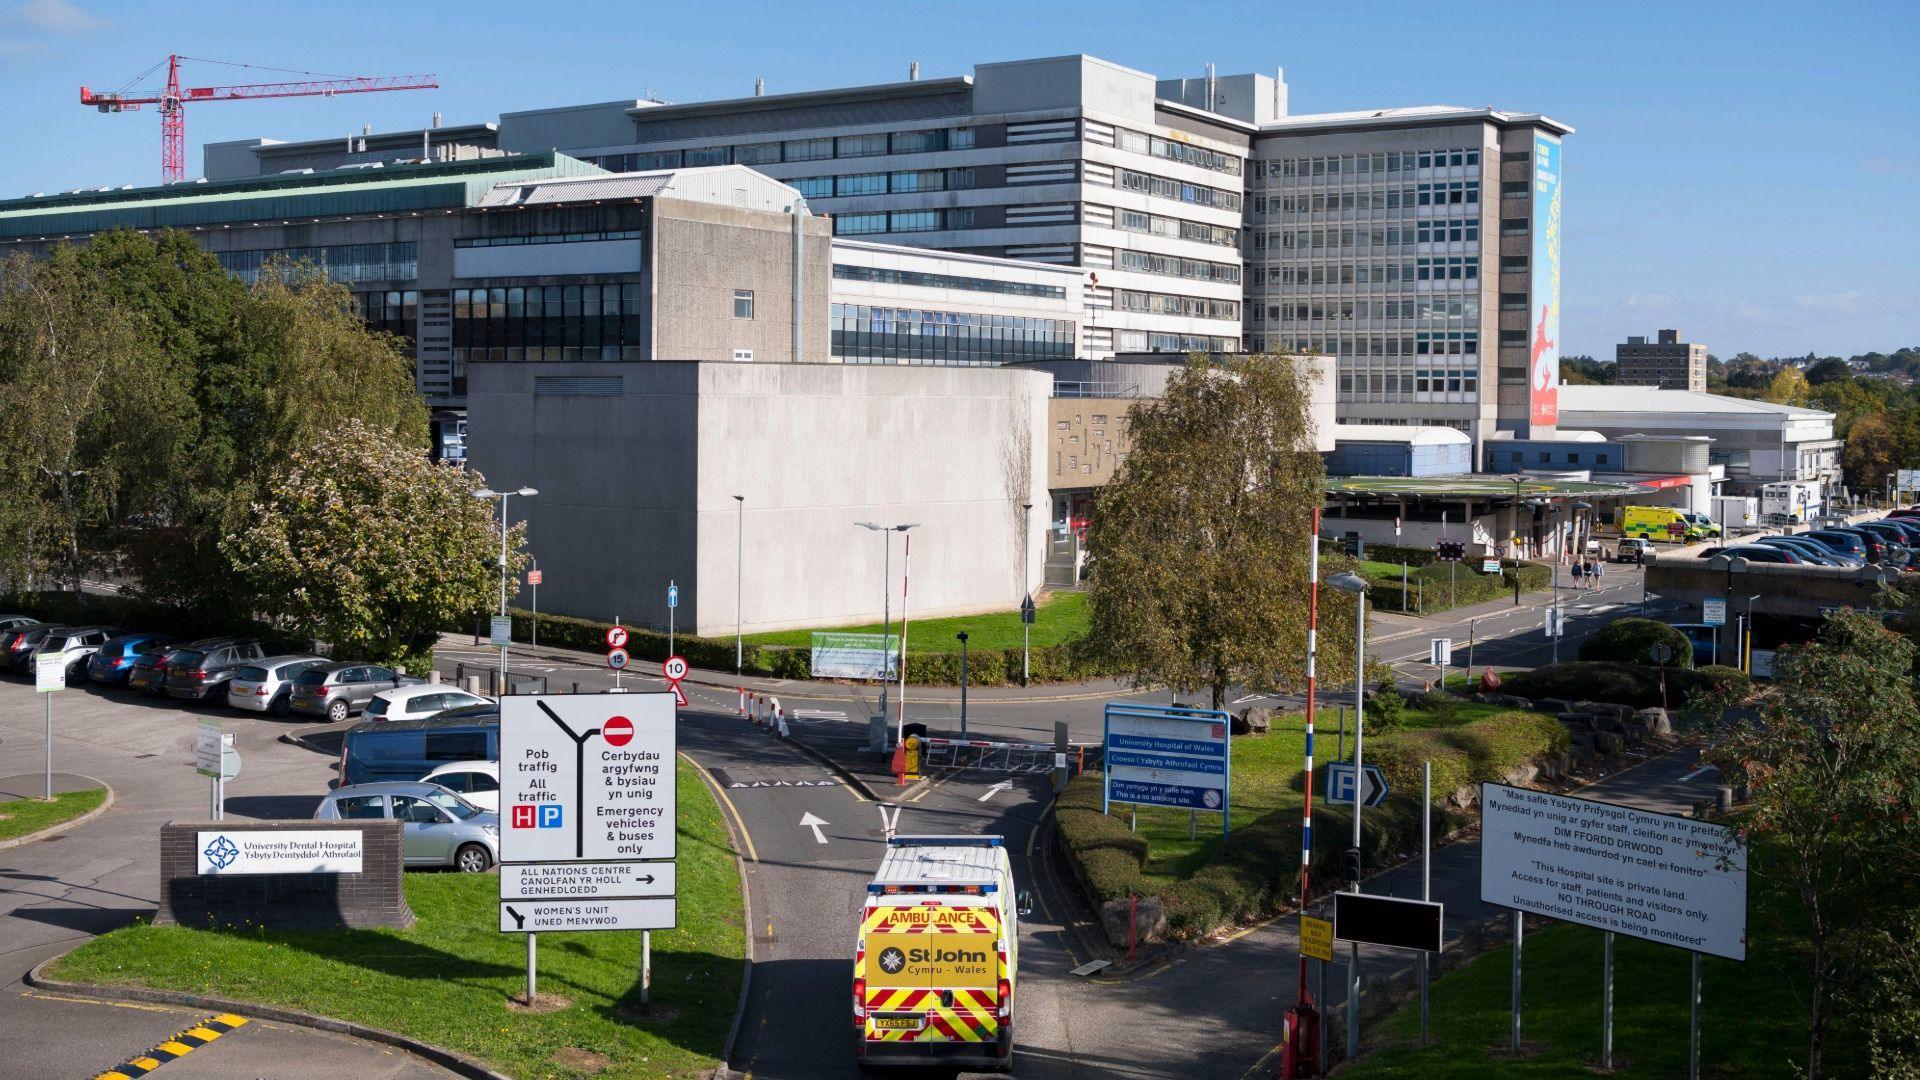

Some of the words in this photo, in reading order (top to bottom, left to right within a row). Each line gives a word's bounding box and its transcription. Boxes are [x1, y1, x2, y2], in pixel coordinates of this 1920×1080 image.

[613, 654, 623, 662] 15
[668, 664, 682, 673] 10
[1120, 738, 1152, 748] University
[1154, 742, 1182, 750] Hospital
[526, 749, 549, 759] Pob
[601, 750, 660, 763] Cerbydau
[519, 762, 557, 772] traffig
[1141, 757, 1163, 766] Ysbyty
[1165, 758, 1198, 769] Athrofaol
[1200, 762, 1222, 771] Cymru
[602, 764, 659, 775] argyfwng
[529, 779, 546, 788] All
[605, 777, 613, 786] &
[617, 776, 656, 787] bysiau
[1126, 783, 1148, 792] ysmygu
[518, 792, 557, 802] traffic
[608, 791, 623, 800] yn
[627, 788, 652, 799] unig
[1151, 795, 1176, 803] smoking
[597, 806, 663, 817] Emergency
[1502, 789, 1524, 801] "Mae
[1527, 793, 1548, 805] safle
[1551, 798, 1581, 813] Ysbyty
[1584, 804, 1625, 820] Prifysgol
[1628, 812, 1660, 826] Cymru
[1663, 820, 1674, 830] yn
[1677, 821, 1688, 831] tir
[517, 808, 532, 826] H
[544, 808, 560, 826] P
[1489, 799, 1531, 816] Mynediad
[1533, 810, 1544, 819] yn
[1547, 812, 1566, 824] unig
[1581, 818, 1605, 830] gyfer
[1607, 823, 1630, 836] staff,
[1633, 827, 1668, 841] cleifion
[1671, 836, 1682, 845] ac
[607, 818, 655, 828] vehicles
[607, 832, 614, 841] &
[620, 831, 654, 841] buses
[290, 841, 317, 849] Dental
[319, 841, 356, 850] Hospital
[1554, 827, 1572, 837] DIM
[1574, 831, 1614, 846] FFORDD
[1617, 840, 1663, 856] DRWODD
[618, 844, 643, 854] only
[1514, 831, 1551, 847] Mynedfa
[1554, 840, 1571, 850] heb
[1573, 845, 1619, 860] awdurdod
[1622, 854, 1634, 864] yn
[1636, 857, 1656, 868] cael
[1659, 860, 1668, 870] ei
[1670, 863, 1708, 877] fonitro"
[244, 851, 271, 860] Ysbyty
[273, 850, 319, 859] Deintyddol
[321, 850, 361, 858] Athrofaol
[542, 867, 588, 875] NATIONS
[591, 866, 632, 875] CENTRE
[521, 877, 576, 885] CANOLFAN
[1531, 860, 1554, 873] "This
[1557, 866, 1594, 882] Hospital
[1597, 876, 1614, 886] site
[1616, 878, 1625, 888] is
[1628, 882, 1661, 896] private
[1664, 888, 1687, 900] land.
[521, 886, 598, 895] GENHEDLOEDD
[1512, 871, 1543, 884] Access
[1546, 878, 1559, 887] for
[1561, 882, 1583, 894] staff,
[1586, 888, 1623, 902] patients
[1626, 895, 1643, 906] and
[1647, 901, 1682, 915] visitors
[1686, 910, 1709, 922] only.
[534, 907, 581, 915] WOMEN'S
[1558, 893, 1572, 903] NO
[1576, 896, 1624, 915] THROUGH
[1627, 908, 1656, 922] ROAD
[566, 917, 618, 925] MENYWOD
[890, 912, 975, 923] AMBULANCE
[1513, 896, 1573, 916] Unauthorised
[1576, 911, 1608, 924] access
[1610, 916, 1618, 926] is
[1622, 921, 1648, 935] being
[1651, 928, 1707, 945] monitored"
[909, 949, 931, 963] St
[933, 949, 986, 963] John
[908, 966, 942, 975] Cymru
[955, 966, 986, 974] Wales
